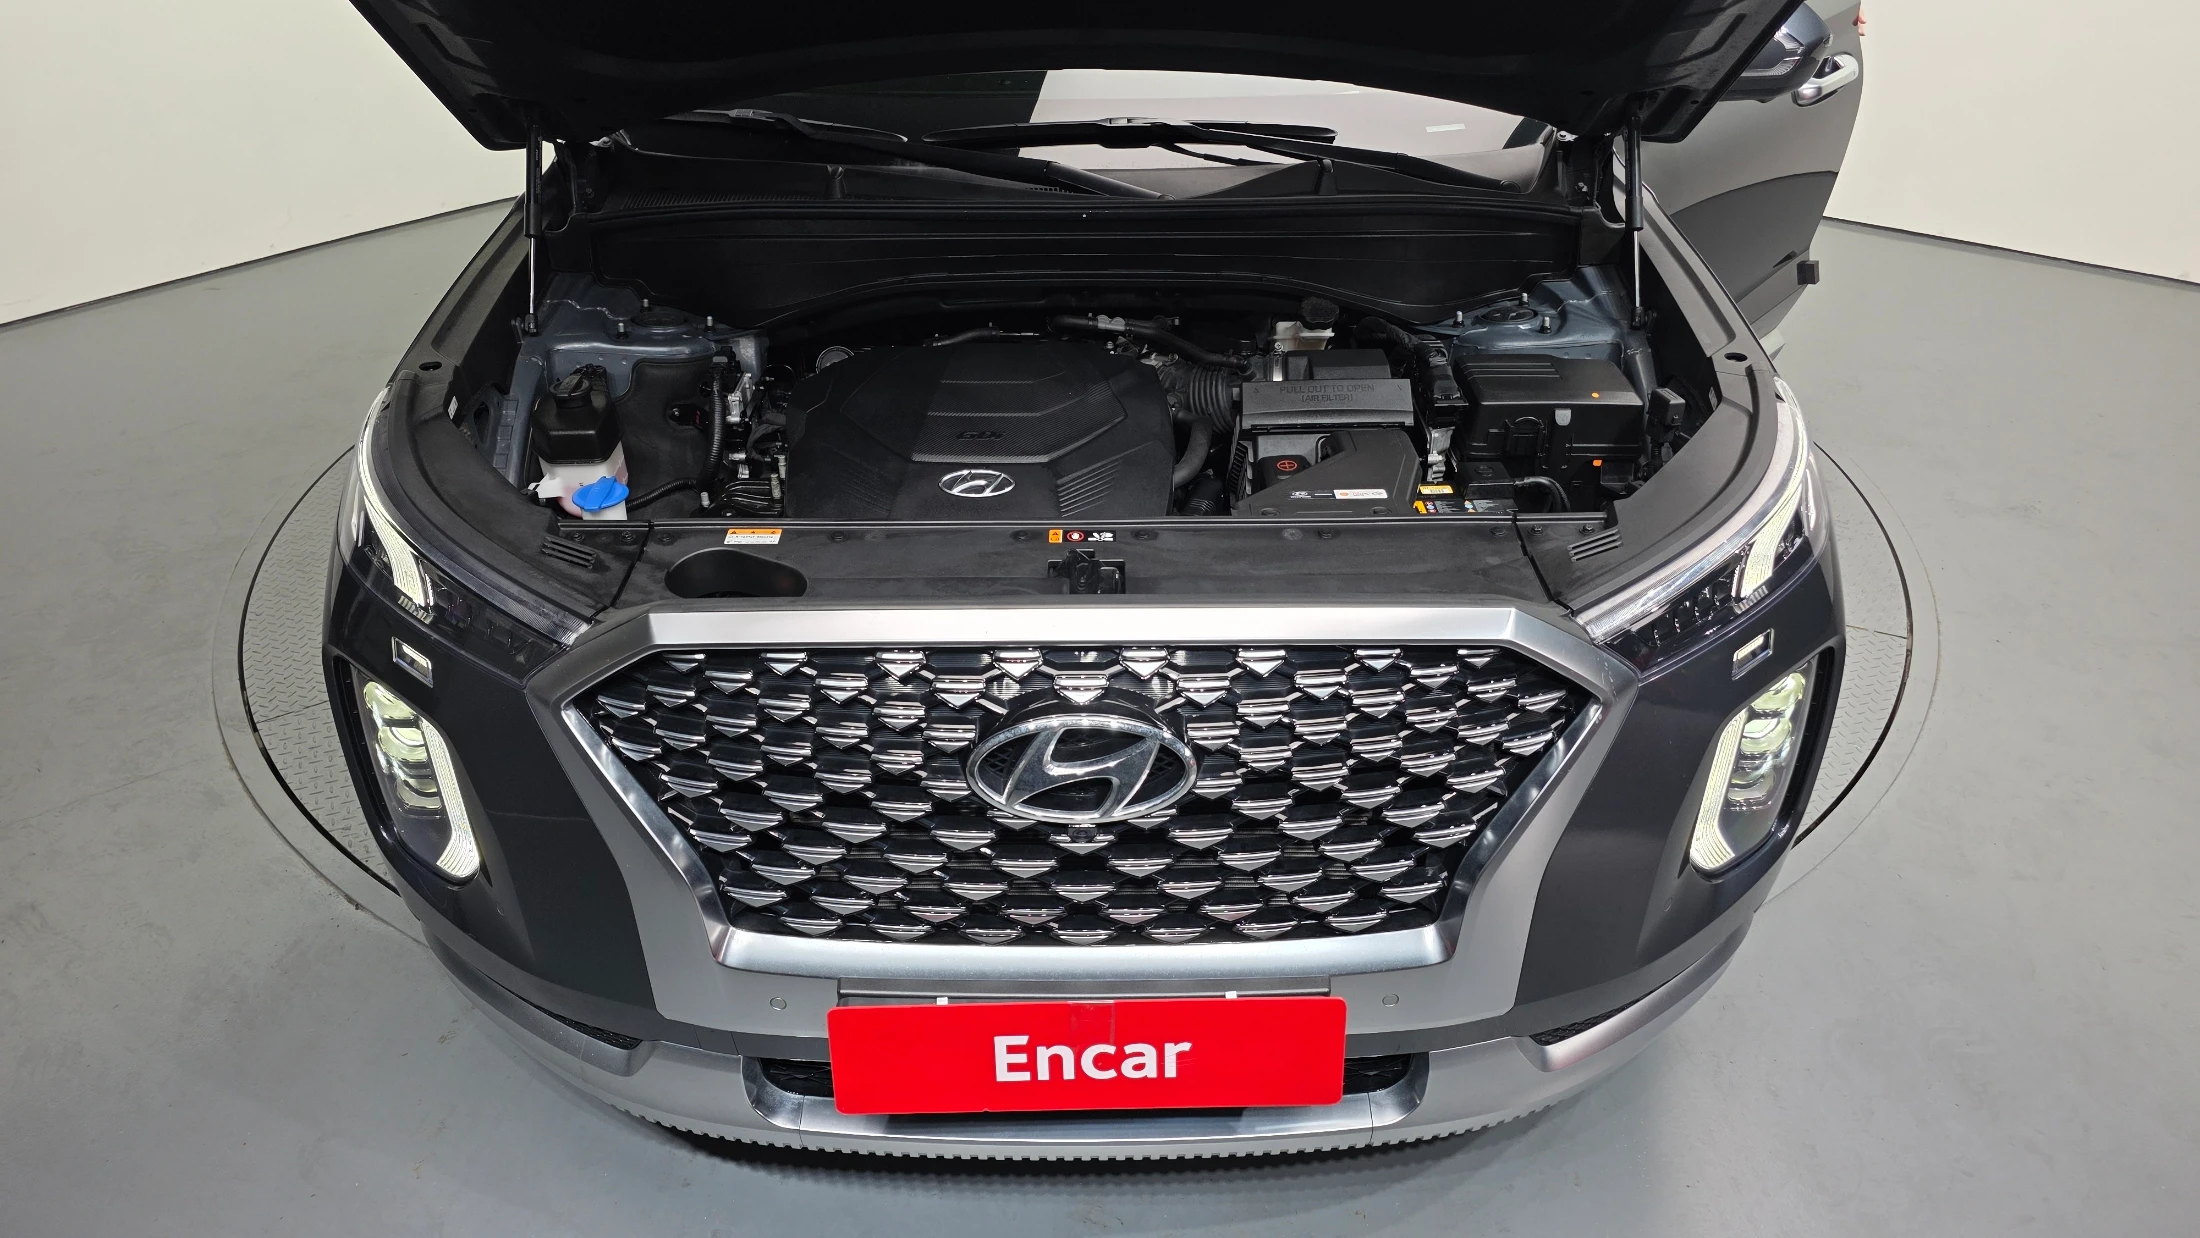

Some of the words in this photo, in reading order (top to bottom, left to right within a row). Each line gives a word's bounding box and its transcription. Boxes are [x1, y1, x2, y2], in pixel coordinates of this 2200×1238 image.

[1279, 385, 1305, 394] PULL
[1307, 385, 1330, 393] OUT
[1332, 384, 1344, 392] TO
[1346, 383, 1375, 392] OPEN
[993, 1034, 1192, 1082] Encar
